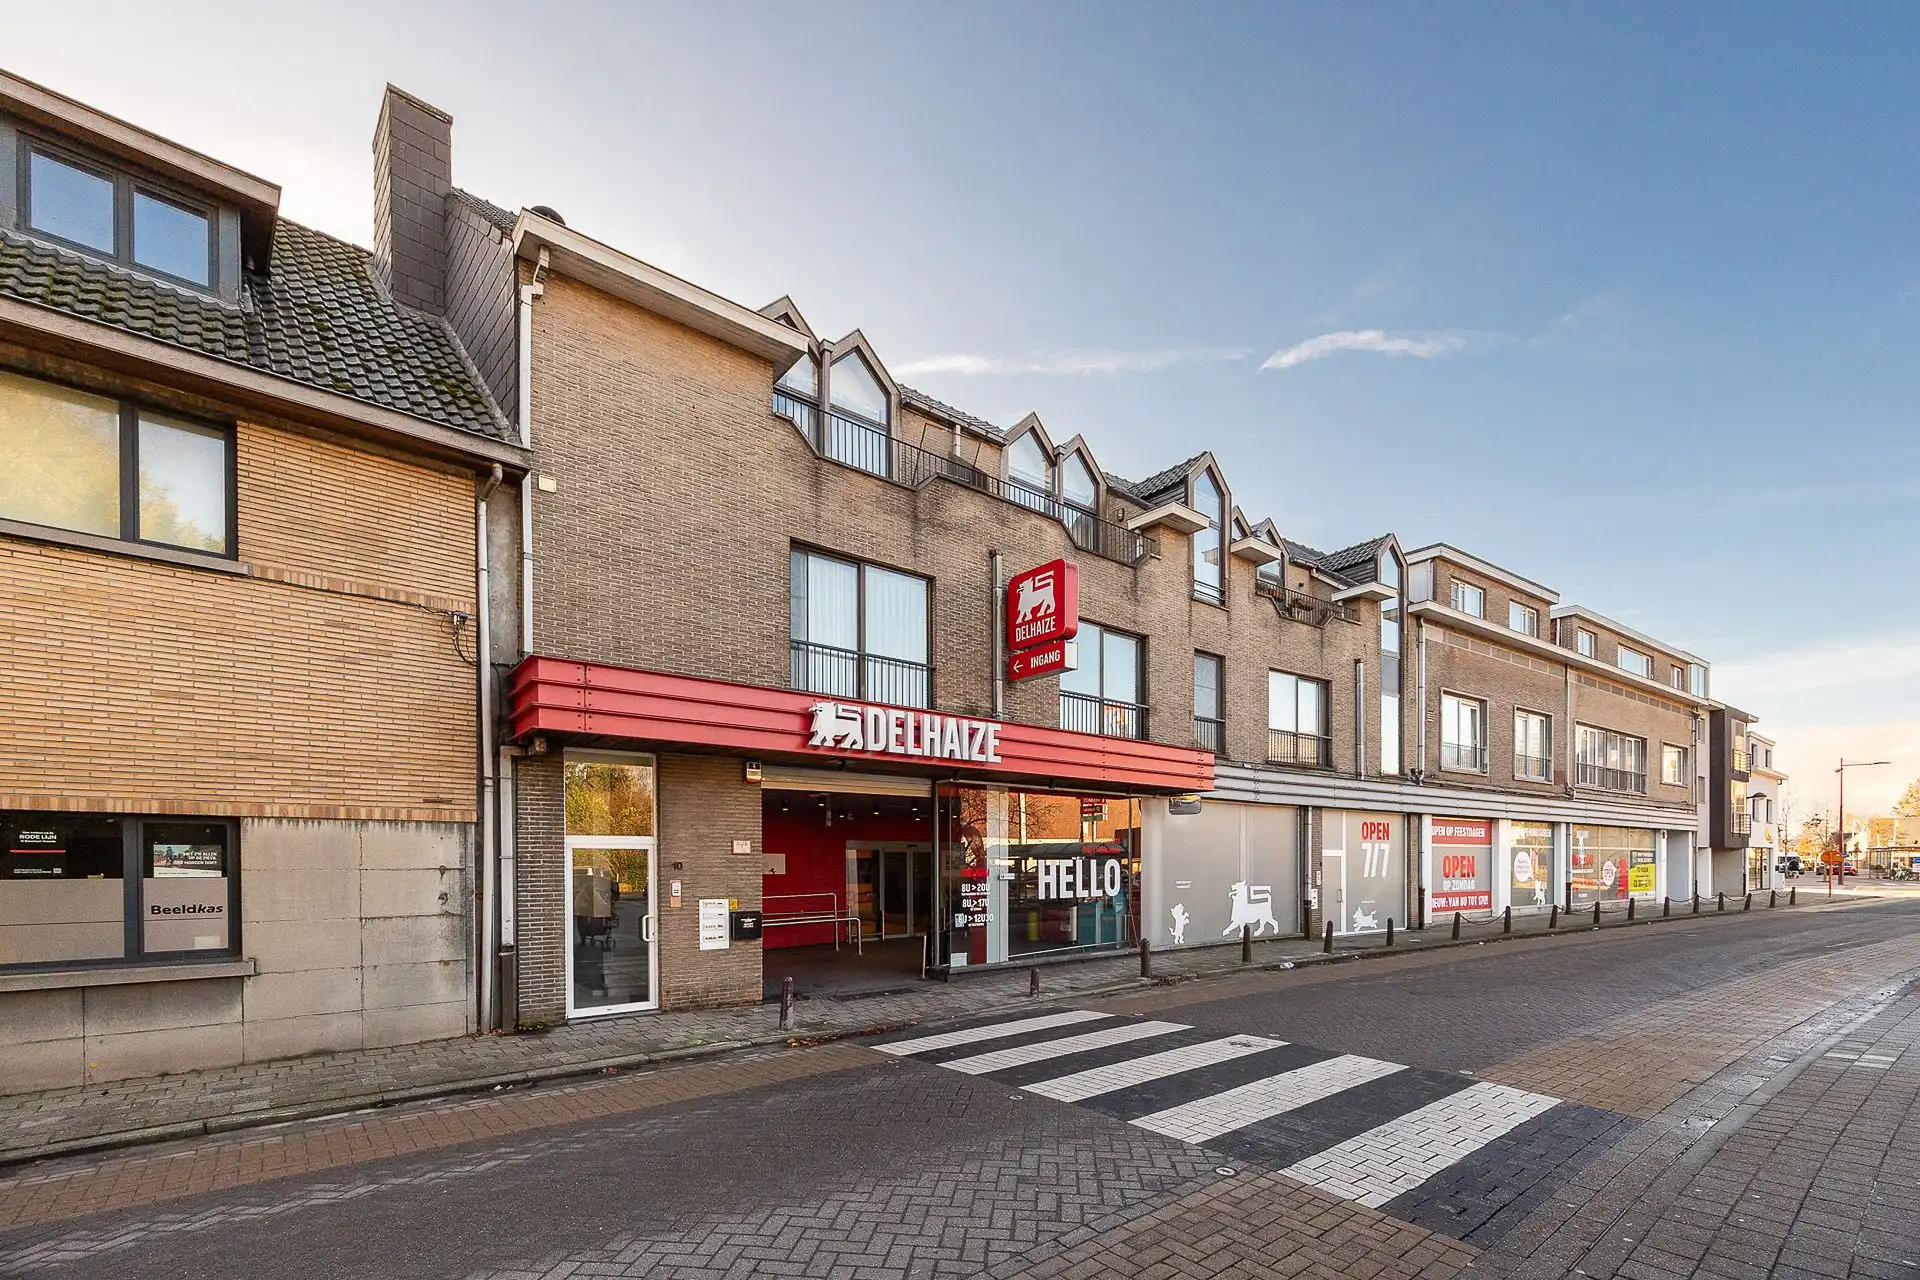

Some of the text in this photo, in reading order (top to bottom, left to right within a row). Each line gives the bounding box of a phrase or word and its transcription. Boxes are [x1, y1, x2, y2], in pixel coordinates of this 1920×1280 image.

[1015, 616, 1056, 642] DELHAIZE
[1030, 649, 1061, 668] INGANG
[864, 706, 1002, 763] DELHAIZE
[1361, 821, 1390, 841] OPEN
[1454, 827, 1486, 838] FEESTDAGEN
[671, 861, 683, 871] 10
[1361, 842, 1390, 878] 7/7
[1442, 855, 1475, 879] OPEN
[1038, 858, 1121, 900] HELLO
[1442, 879, 1476, 892] OP ZONDAG
[150, 904, 224, 915] Beeldkas
